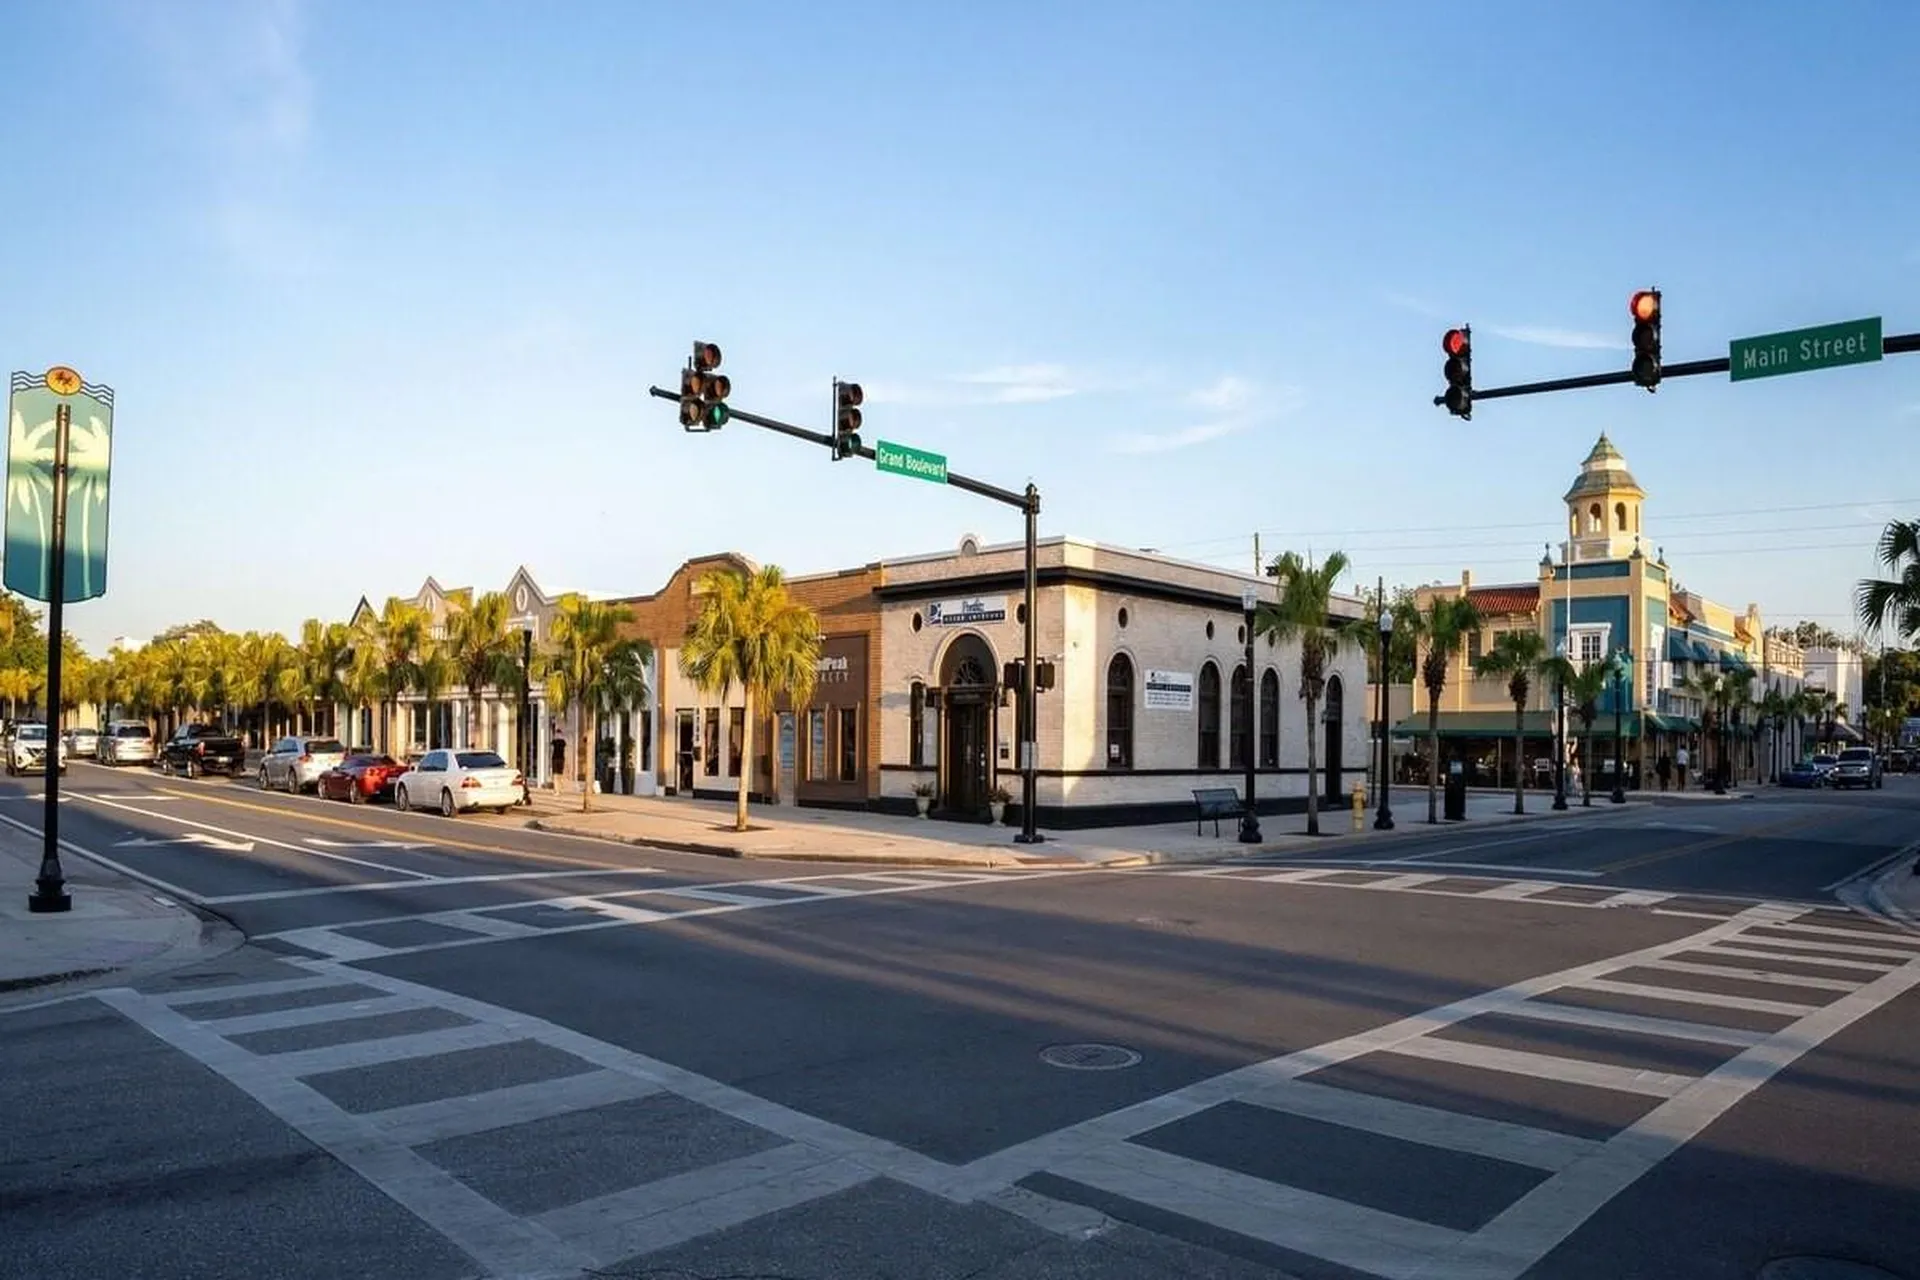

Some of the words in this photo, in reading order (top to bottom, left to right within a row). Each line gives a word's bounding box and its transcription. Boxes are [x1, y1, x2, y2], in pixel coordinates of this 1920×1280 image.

[1744, 345, 1788, 370] Main
[1800, 332, 1867, 361] Street
[879, 448, 904, 468] Grand
[905, 454, 945, 478] Boulevard
